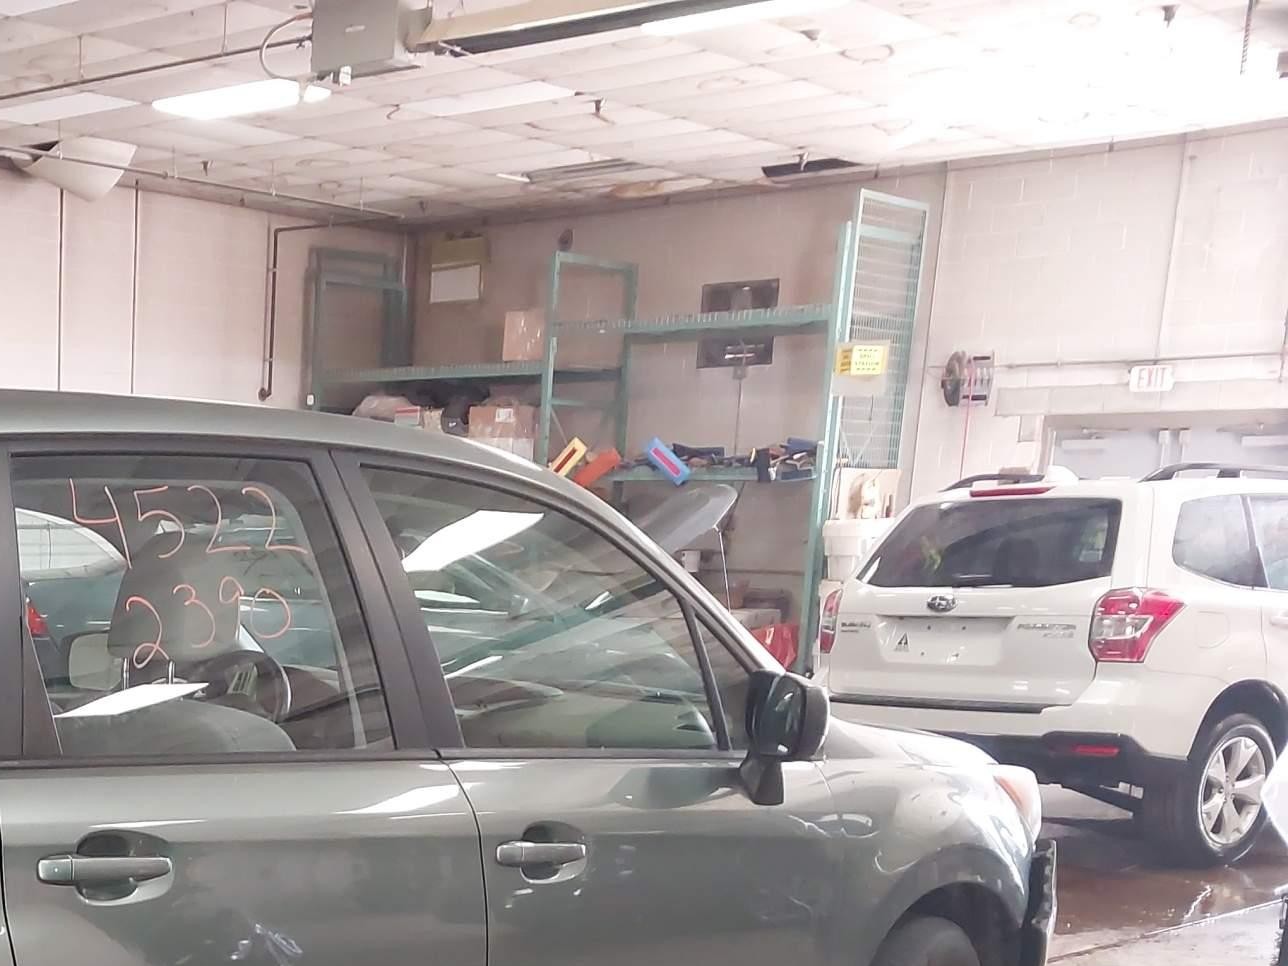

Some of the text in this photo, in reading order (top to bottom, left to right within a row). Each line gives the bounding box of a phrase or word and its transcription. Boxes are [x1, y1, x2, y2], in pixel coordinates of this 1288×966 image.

[1137, 367, 1168, 389] EXIT
[69, 478, 309, 569] 4522
[126, 576, 292, 669] 2390
